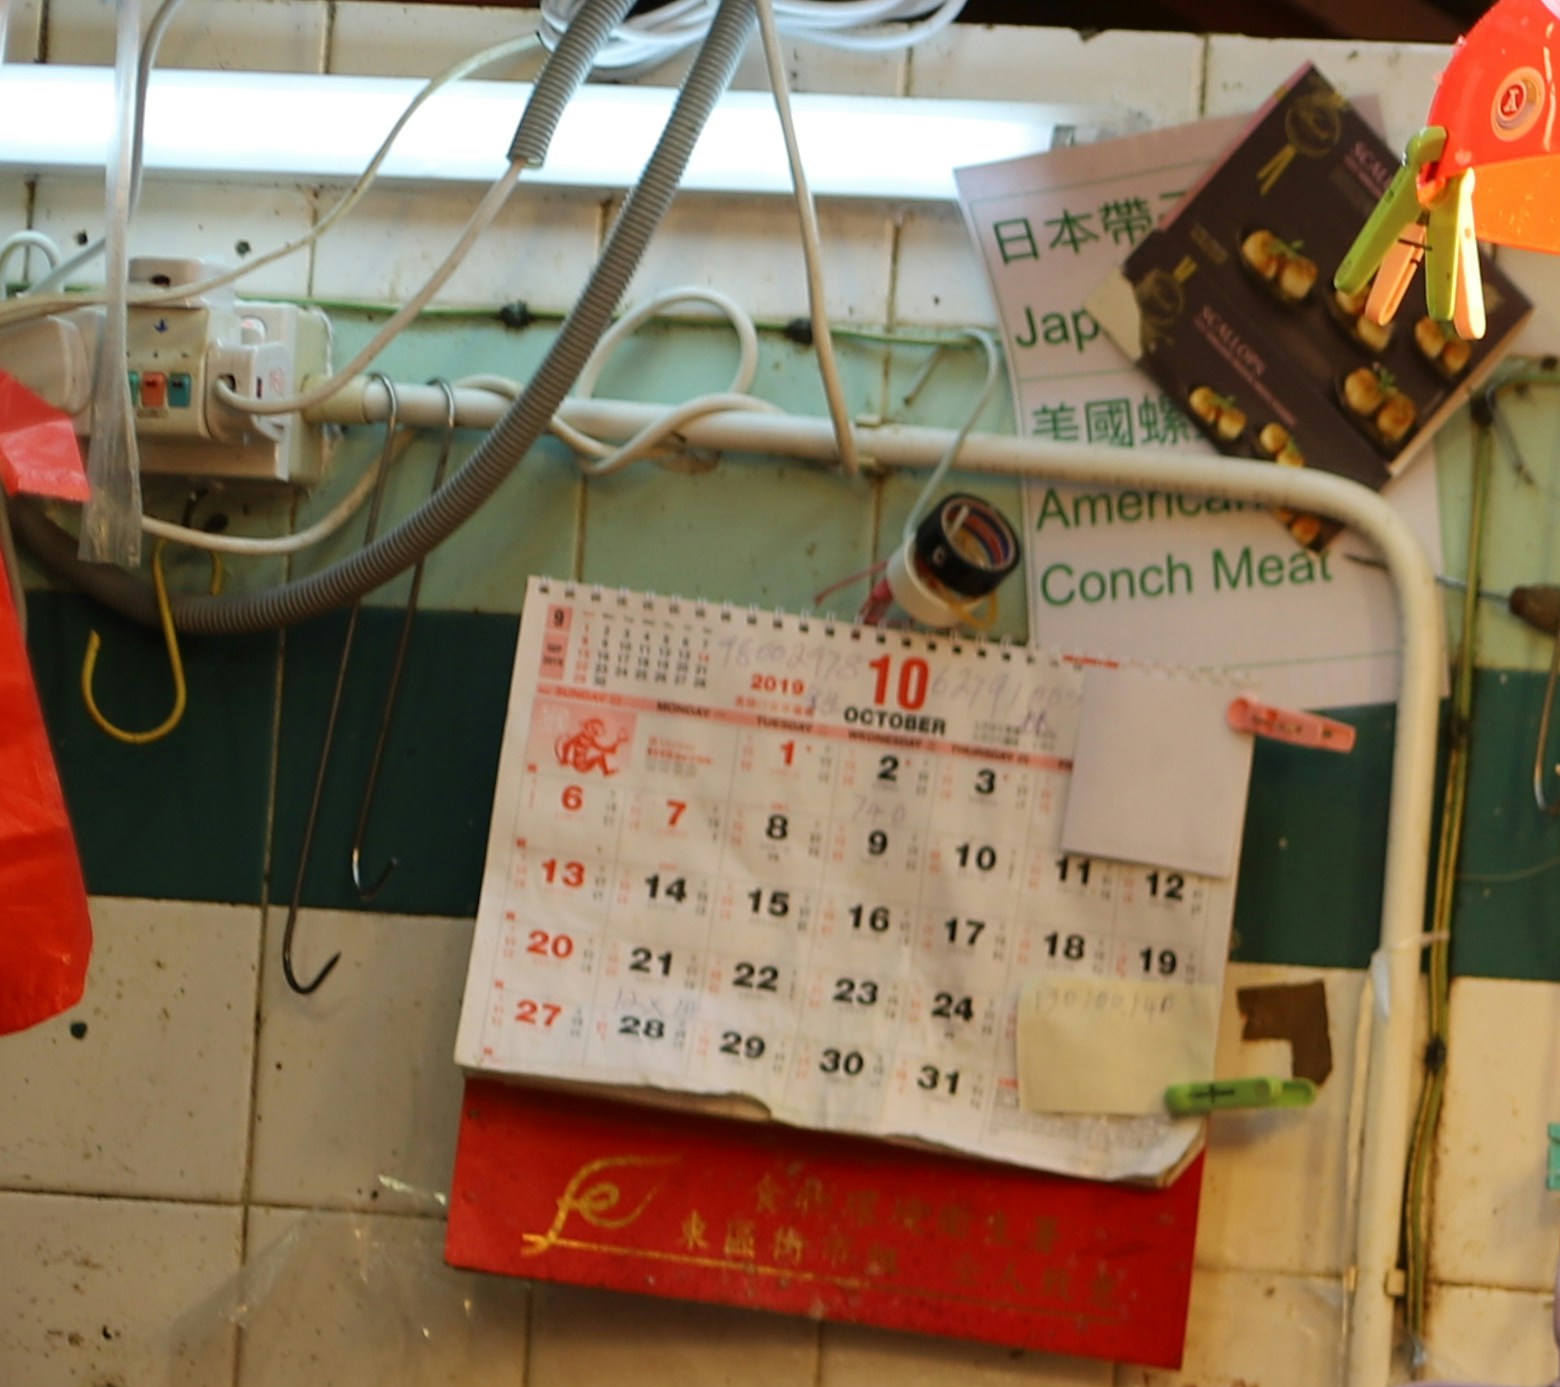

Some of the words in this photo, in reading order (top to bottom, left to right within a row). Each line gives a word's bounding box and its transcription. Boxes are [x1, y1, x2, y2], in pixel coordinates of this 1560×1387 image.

[993, 190, 1187, 265] 日本帶
[1033, 394, 1205, 448] 美國螺
[1041, 554, 1192, 606] Conch
[1212, 545, 1332, 591] Meat
[751, 673, 805, 697] 2019
[868, 653, 930, 712] 10
[656, 701, 711, 720] MONDAY
[756, 714, 814, 734] TUESDAY
[847, 729, 924, 751] WEDNESDAY
[950, 743, 1015, 763] THURSDAY
[844, 707, 947, 736] OCTOBER
[779, 740, 795, 767] 1
[877, 755, 900, 783] 2
[974, 769, 998, 796] 3
[561, 785, 584, 811] 6
[666, 800, 688, 827] 7
[765, 814, 789, 840] 8
[867, 830, 889, 857] 9
[955, 842, 997, 873] 10
[1055, 855, 1092, 886] 11
[1146, 870, 1186, 902] 12
[542, 859, 586, 888] 13
[645, 874, 688, 903] 14
[748, 889, 791, 918] 15
[848, 904, 891, 934] 16
[944, 918, 986, 948] 17
[1045, 932, 1086, 961] 18
[1140, 946, 1178, 977] 19
[526, 929, 575, 959] 20
[629, 947, 674, 976] 21
[732, 962, 779, 992] 22
[832, 977, 880, 1007] 23
[931, 992, 975, 1022] 24
[515, 999, 562, 1028] 27
[618, 1015, 666, 1040] 28
[719, 1031, 766, 1060] 29
[819, 1048, 865, 1077] 30
[917, 1063, 961, 1096] 31
